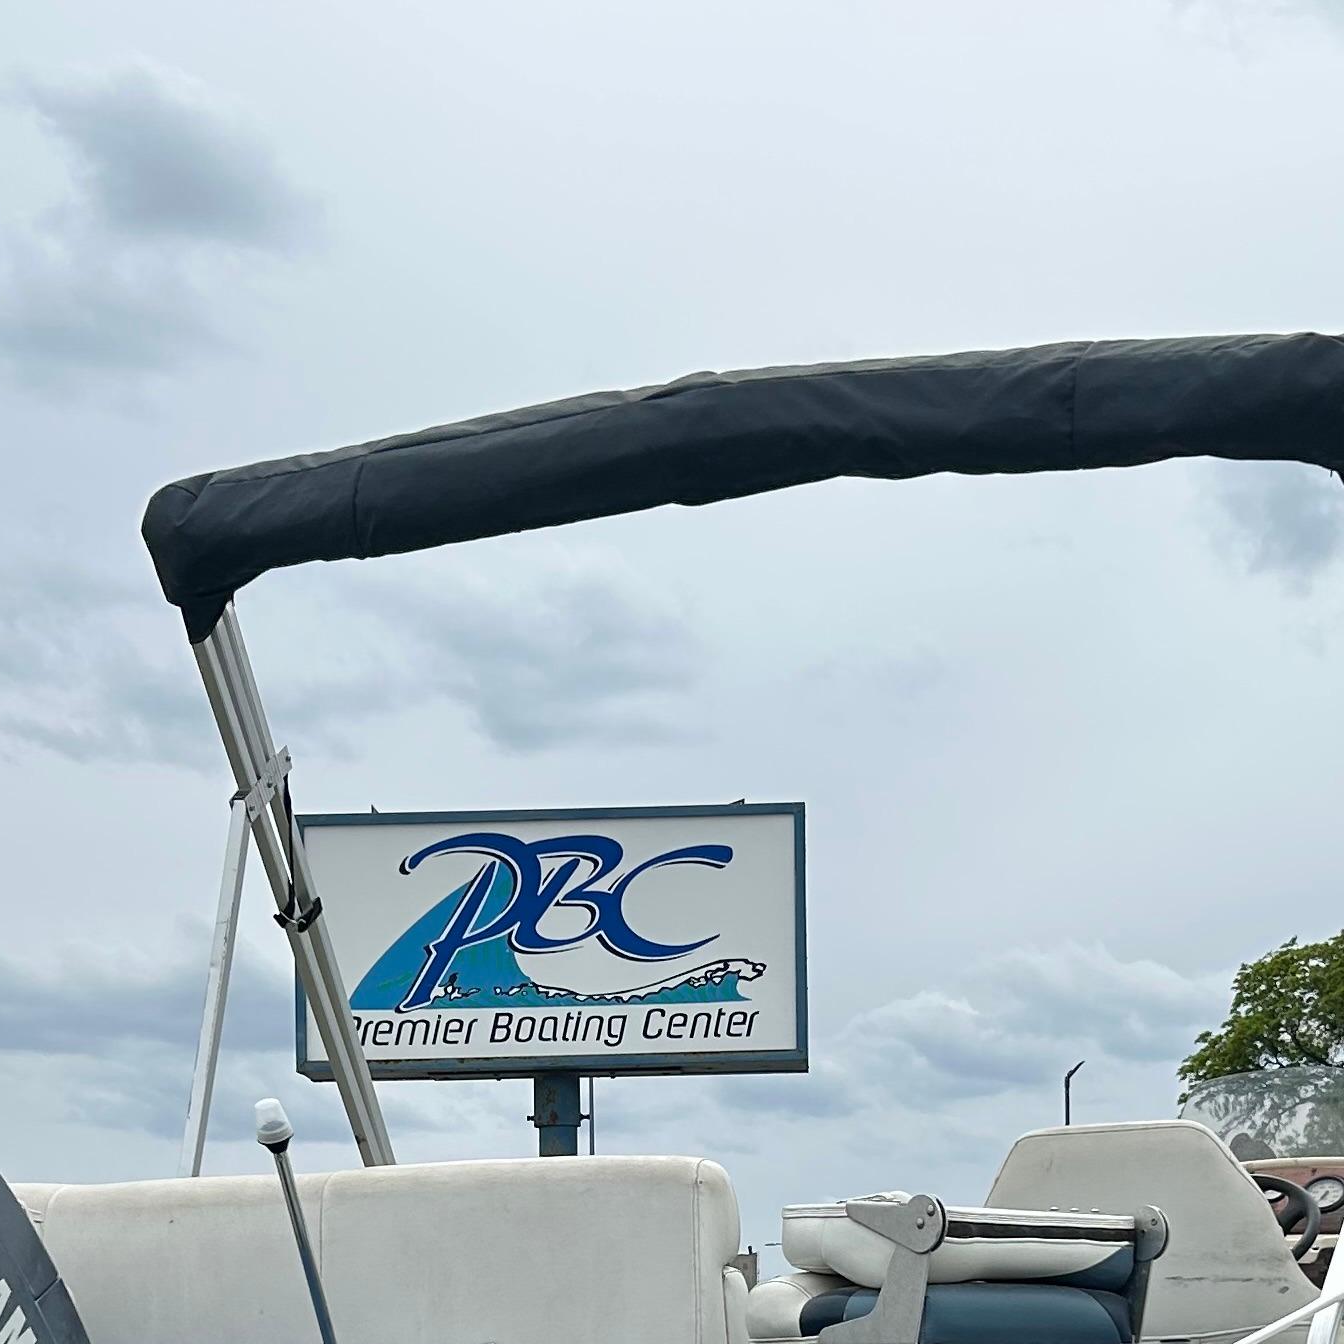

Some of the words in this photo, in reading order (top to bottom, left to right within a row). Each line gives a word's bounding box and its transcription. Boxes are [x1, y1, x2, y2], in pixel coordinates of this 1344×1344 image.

[394, 832, 733, 1013] PBC
[490, 1012, 627, 1046] Boating
[642, 1007, 760, 1040] Center
